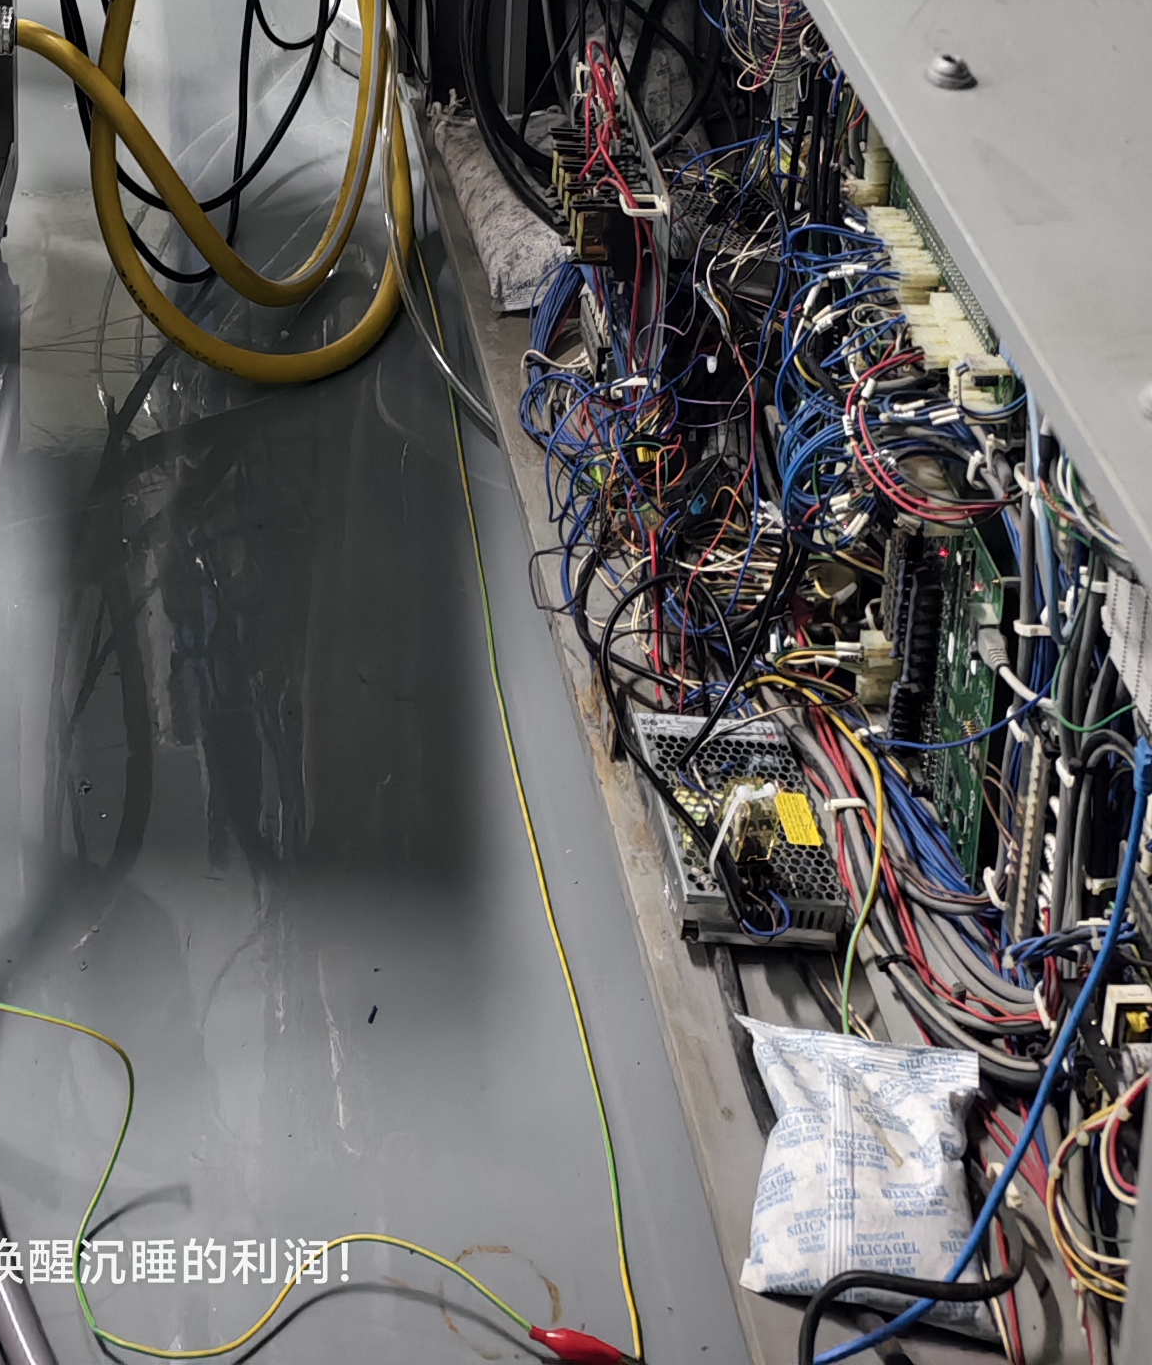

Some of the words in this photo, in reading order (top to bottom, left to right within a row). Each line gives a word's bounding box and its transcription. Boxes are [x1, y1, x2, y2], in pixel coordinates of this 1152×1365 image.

[898, 1055, 940, 1071] SILICA
[787, 1219, 826, 1237] SILICA
[847, 1244, 893, 1256] SILICA
[893, 1242, 921, 1255] GEL
